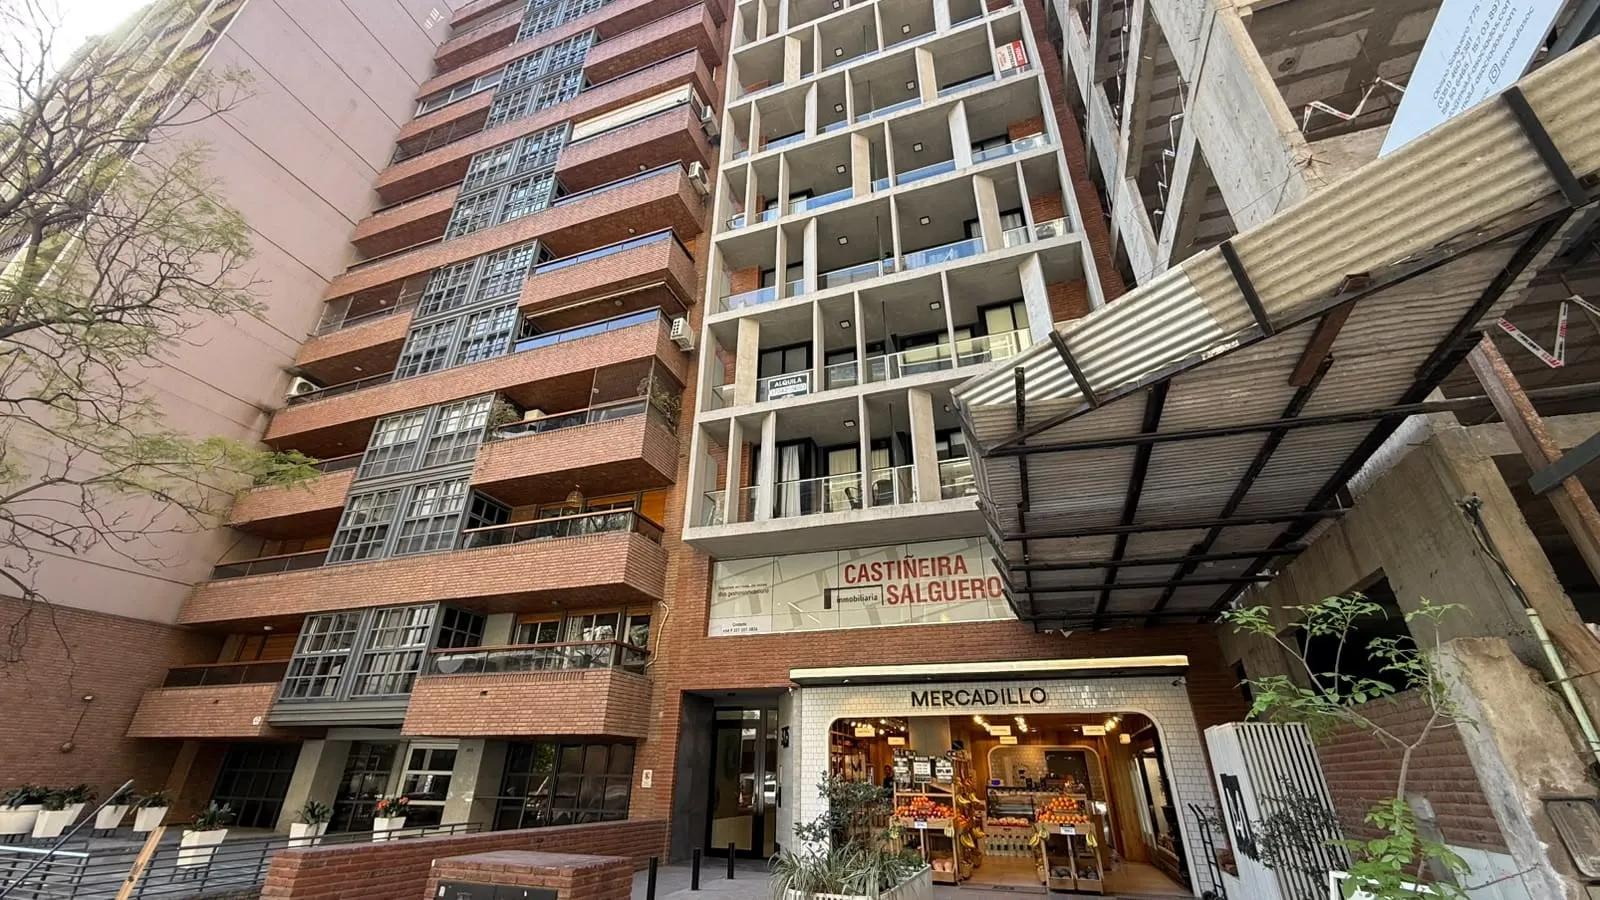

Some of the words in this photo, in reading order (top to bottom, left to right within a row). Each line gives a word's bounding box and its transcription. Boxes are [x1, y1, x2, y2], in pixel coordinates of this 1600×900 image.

[774, 377, 802, 388] ALQUILA
[844, 554, 968, 584] CASTIÑEIRA
[837, 594, 878, 604] inmobiliaria
[886, 576, 1003, 605] SALGUERO
[911, 687, 1047, 707] MERCADILLO
